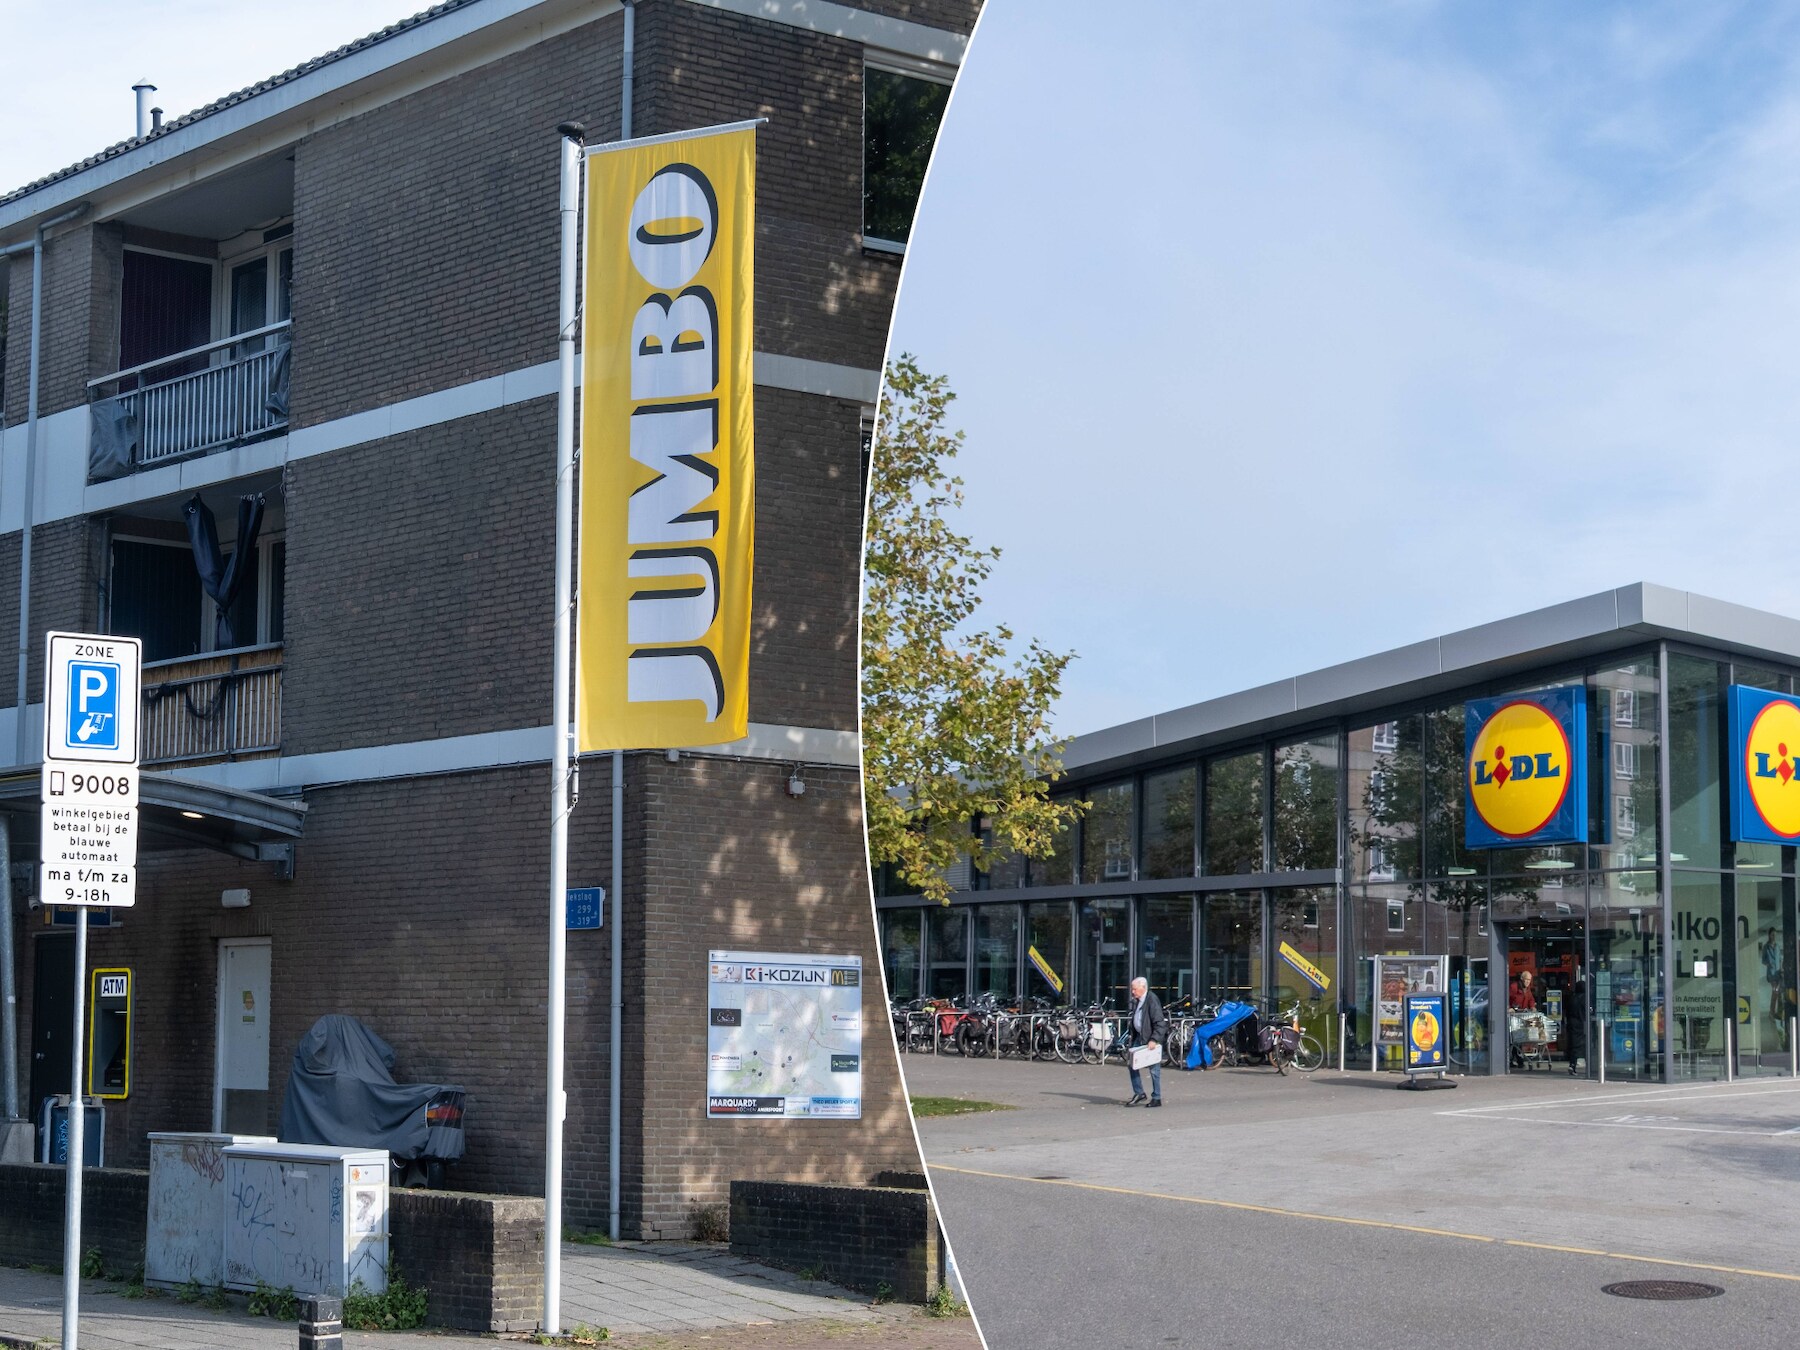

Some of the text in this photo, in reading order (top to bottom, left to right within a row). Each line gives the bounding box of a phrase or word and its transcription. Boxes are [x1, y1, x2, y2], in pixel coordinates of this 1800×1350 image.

[627, 162, 724, 723] JUMBO
[75, 645, 114, 658] ZONE
[79, 669, 108, 713] P
[71, 774, 130, 795] 9008
[51, 808, 130, 821] winkelgebied
[53, 822, 127, 836] betaal bij de
[70, 837, 111, 848] blauwe
[61, 851, 118, 862] automaat
[48, 869, 128, 883] ma t/m za
[65, 888, 110, 902] 9-18h
[577, 905, 592, 914] 299
[577, 916, 591, 926] 319
[103, 979, 124, 994] ATM
[1683, 995, 1721, 1003] Amersfoort
[711, 1098, 757, 1107] MARQUARDT
